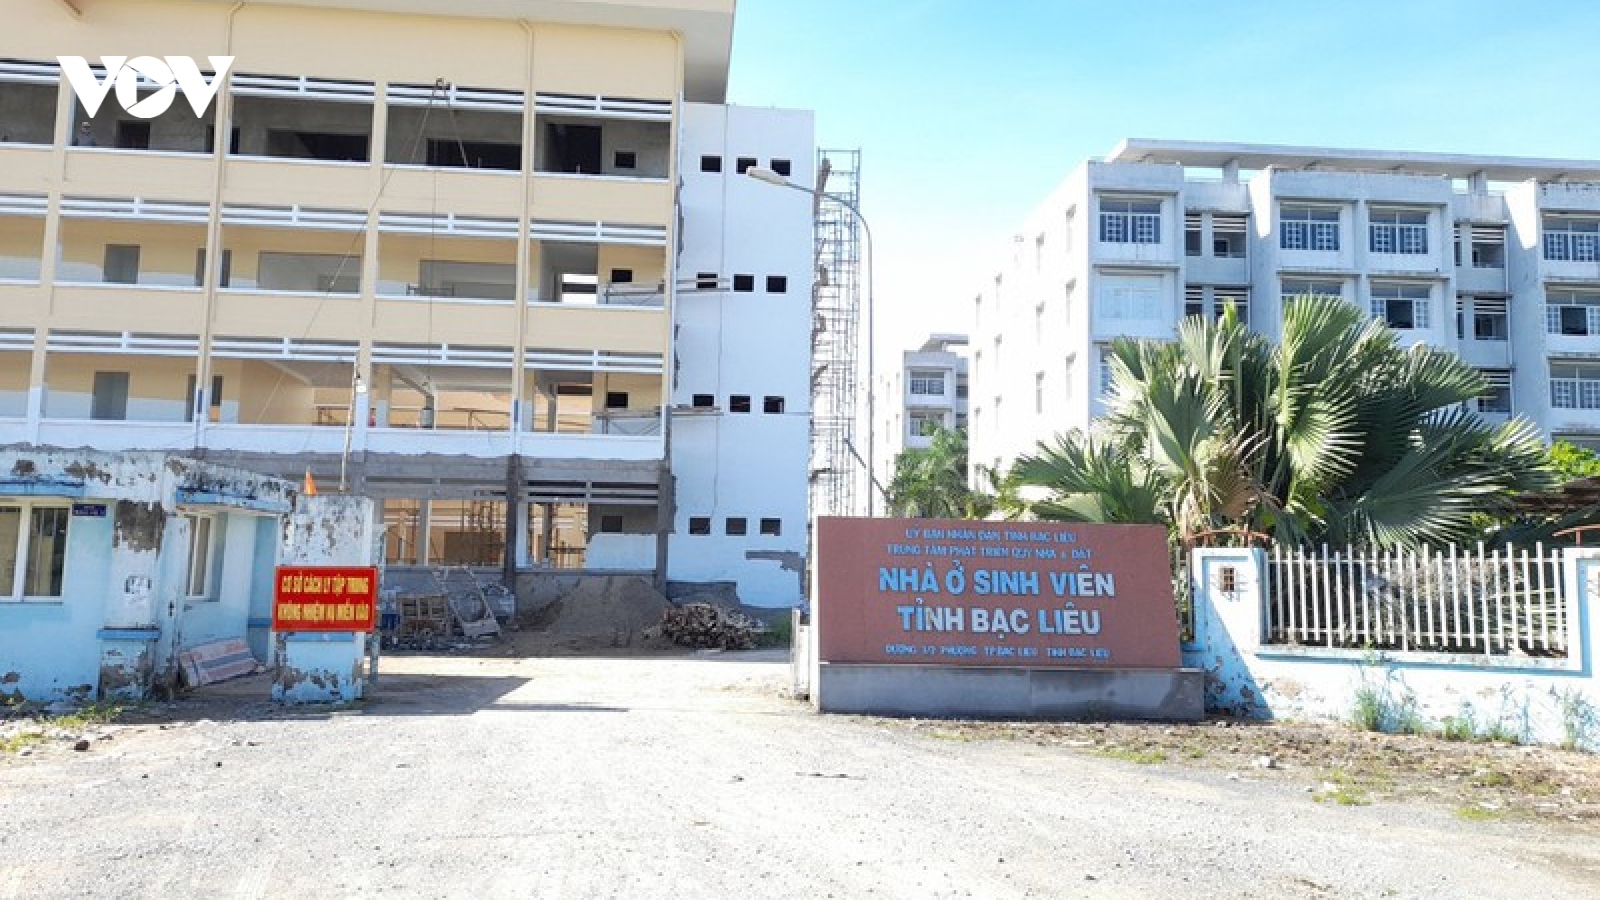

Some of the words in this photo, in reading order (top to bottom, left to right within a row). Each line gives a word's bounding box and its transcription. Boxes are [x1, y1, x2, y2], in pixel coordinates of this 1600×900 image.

[303, 572, 322, 593] CÁCH
[347, 577, 369, 593] TRUNG
[879, 561, 939, 592] NHÀ
[973, 569, 1040, 596] SINH
[1050, 563, 1116, 598] VIÊN
[897, 597, 965, 632] TỈNH
[971, 607, 1030, 640] BẠC
[1037, 601, 1100, 635] LIÊU
